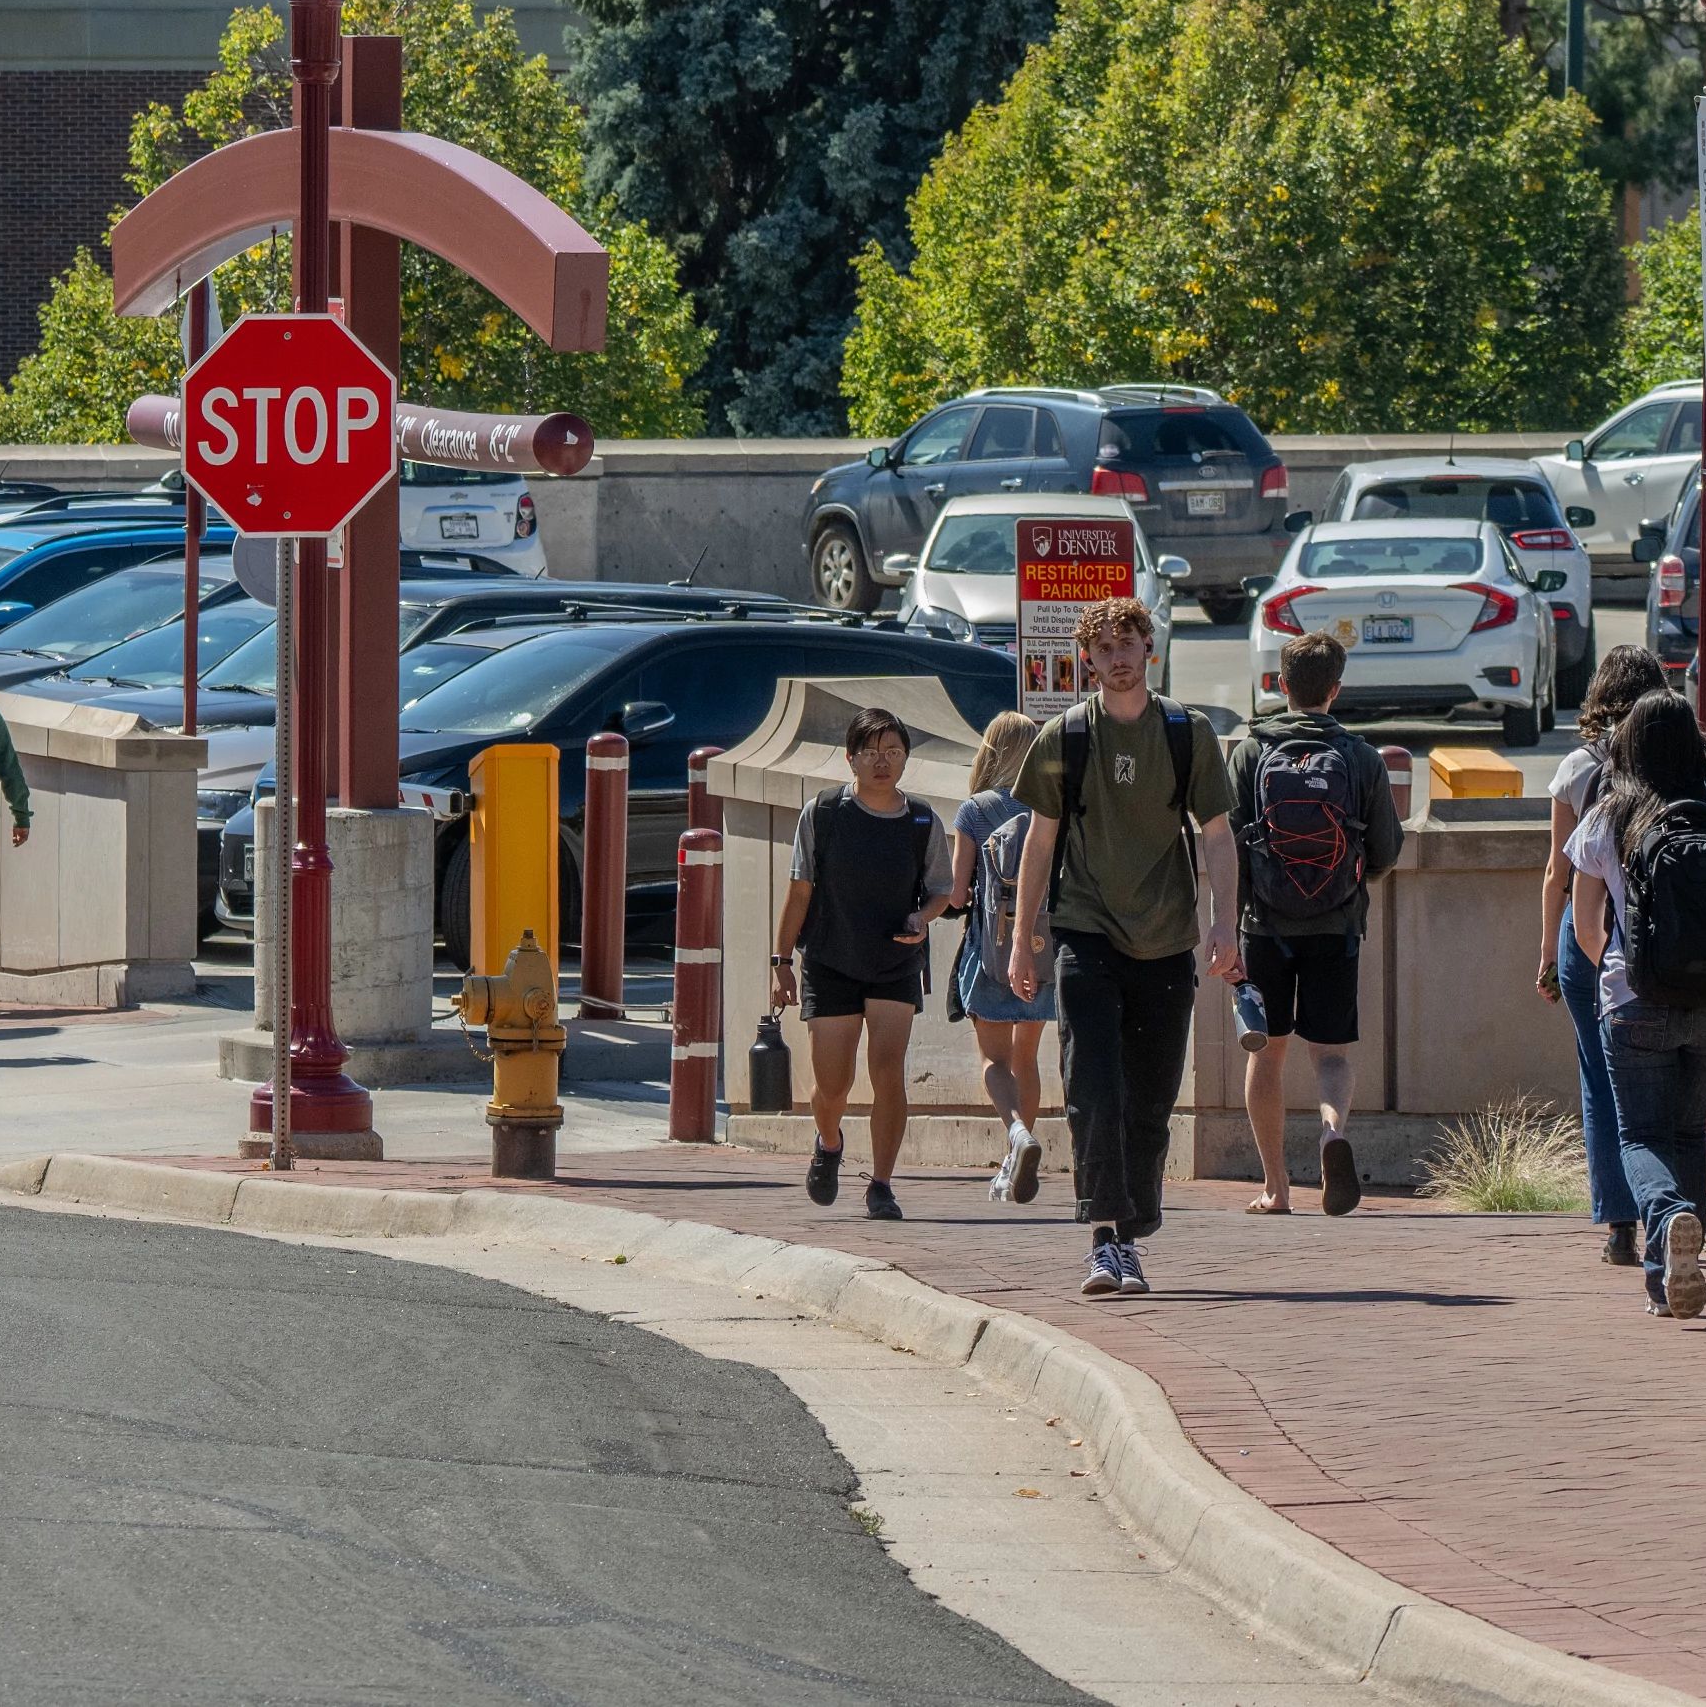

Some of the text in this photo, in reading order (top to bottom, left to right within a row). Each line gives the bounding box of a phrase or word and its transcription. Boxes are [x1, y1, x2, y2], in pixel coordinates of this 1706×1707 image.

[197, 386, 380, 466] STOP
[421, 419, 479, 461] Clearance
[1058, 530, 1110, 540] UNIVERSITY
[1058, 540, 1119, 555] DENVER
[1026, 565, 1127, 581] RESTRICTED
[1041, 583, 1112, 599] PARKING
[1052, 606, 1061, 614] Up
[1051, 616, 1076, 626] Display
